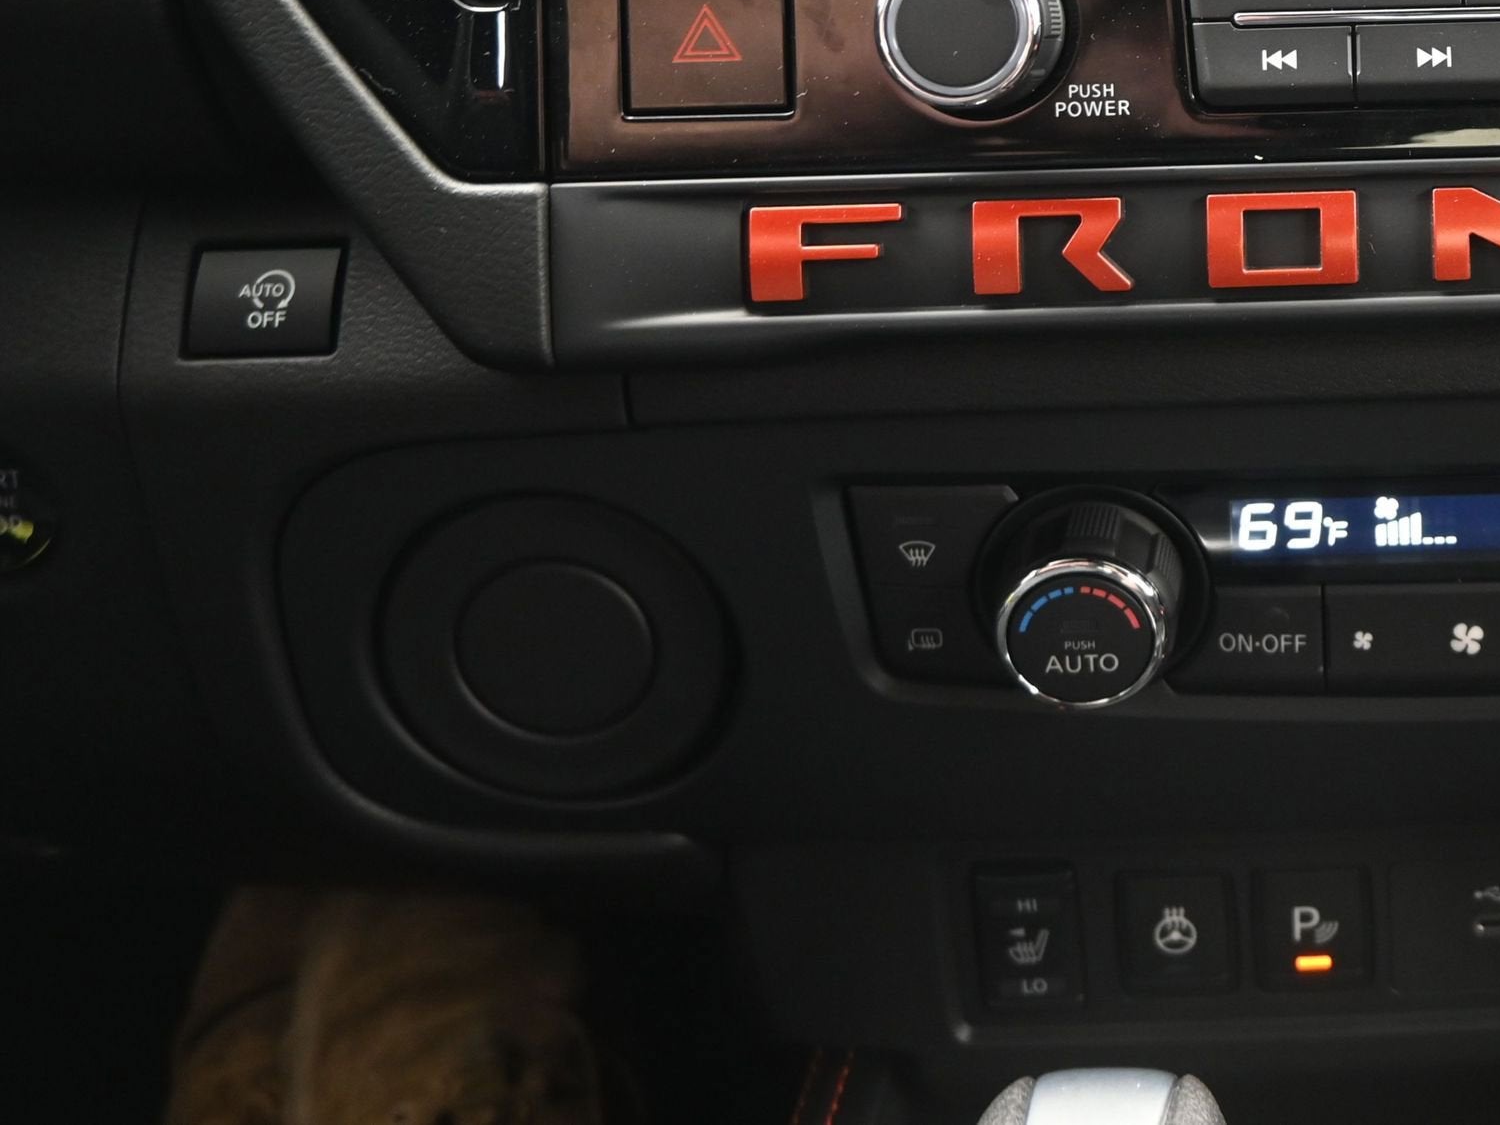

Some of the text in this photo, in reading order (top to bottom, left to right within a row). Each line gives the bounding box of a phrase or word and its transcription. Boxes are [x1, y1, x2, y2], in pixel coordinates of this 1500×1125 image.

[1067, 83, 1115, 99] PUSH
[1054, 100, 1131, 118] POWER
[239, 283, 285, 298] AUTO
[246, 310, 287, 329] OFF
[1063, 639, 1097, 651] PUSH
[1044, 652, 1120, 676] AUTO
[1017, 899, 1038, 912] HI
[1293, 906, 1321, 941] P
[1023, 978, 1049, 994] LO
